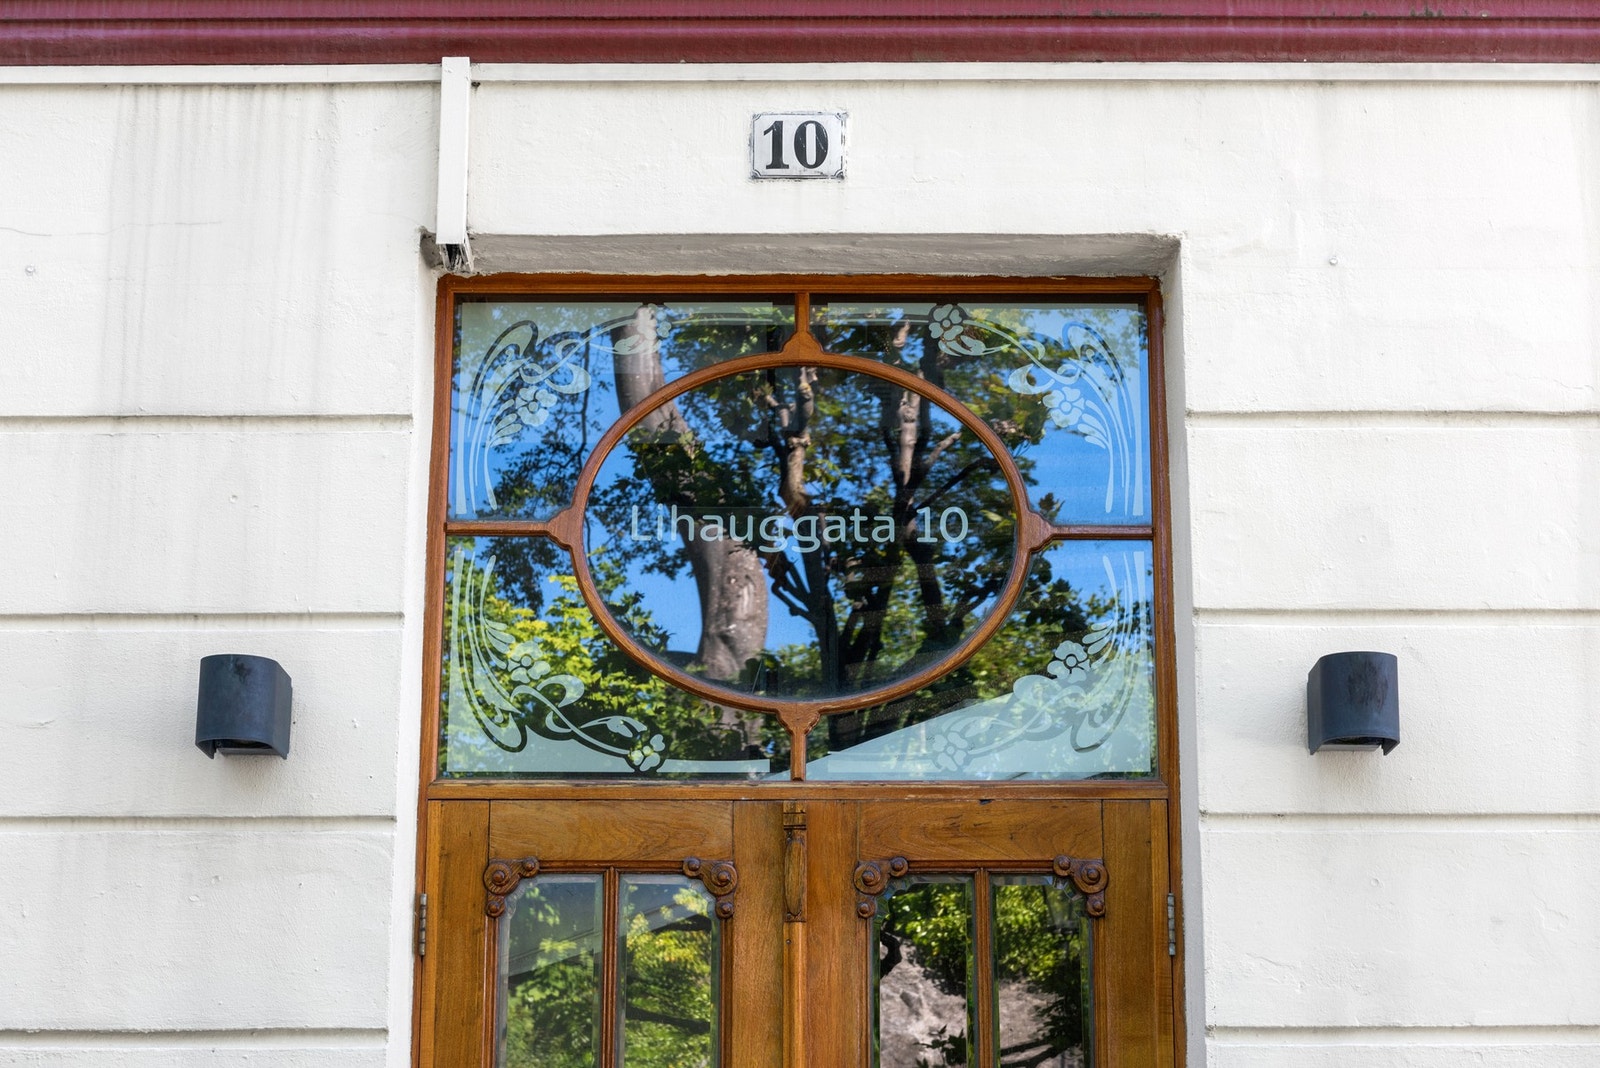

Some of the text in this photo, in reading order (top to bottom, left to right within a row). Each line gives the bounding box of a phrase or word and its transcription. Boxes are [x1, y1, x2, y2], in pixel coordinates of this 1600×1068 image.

[763, 120, 829, 169] 10
[631, 503, 969, 553] Lihauggata 10
